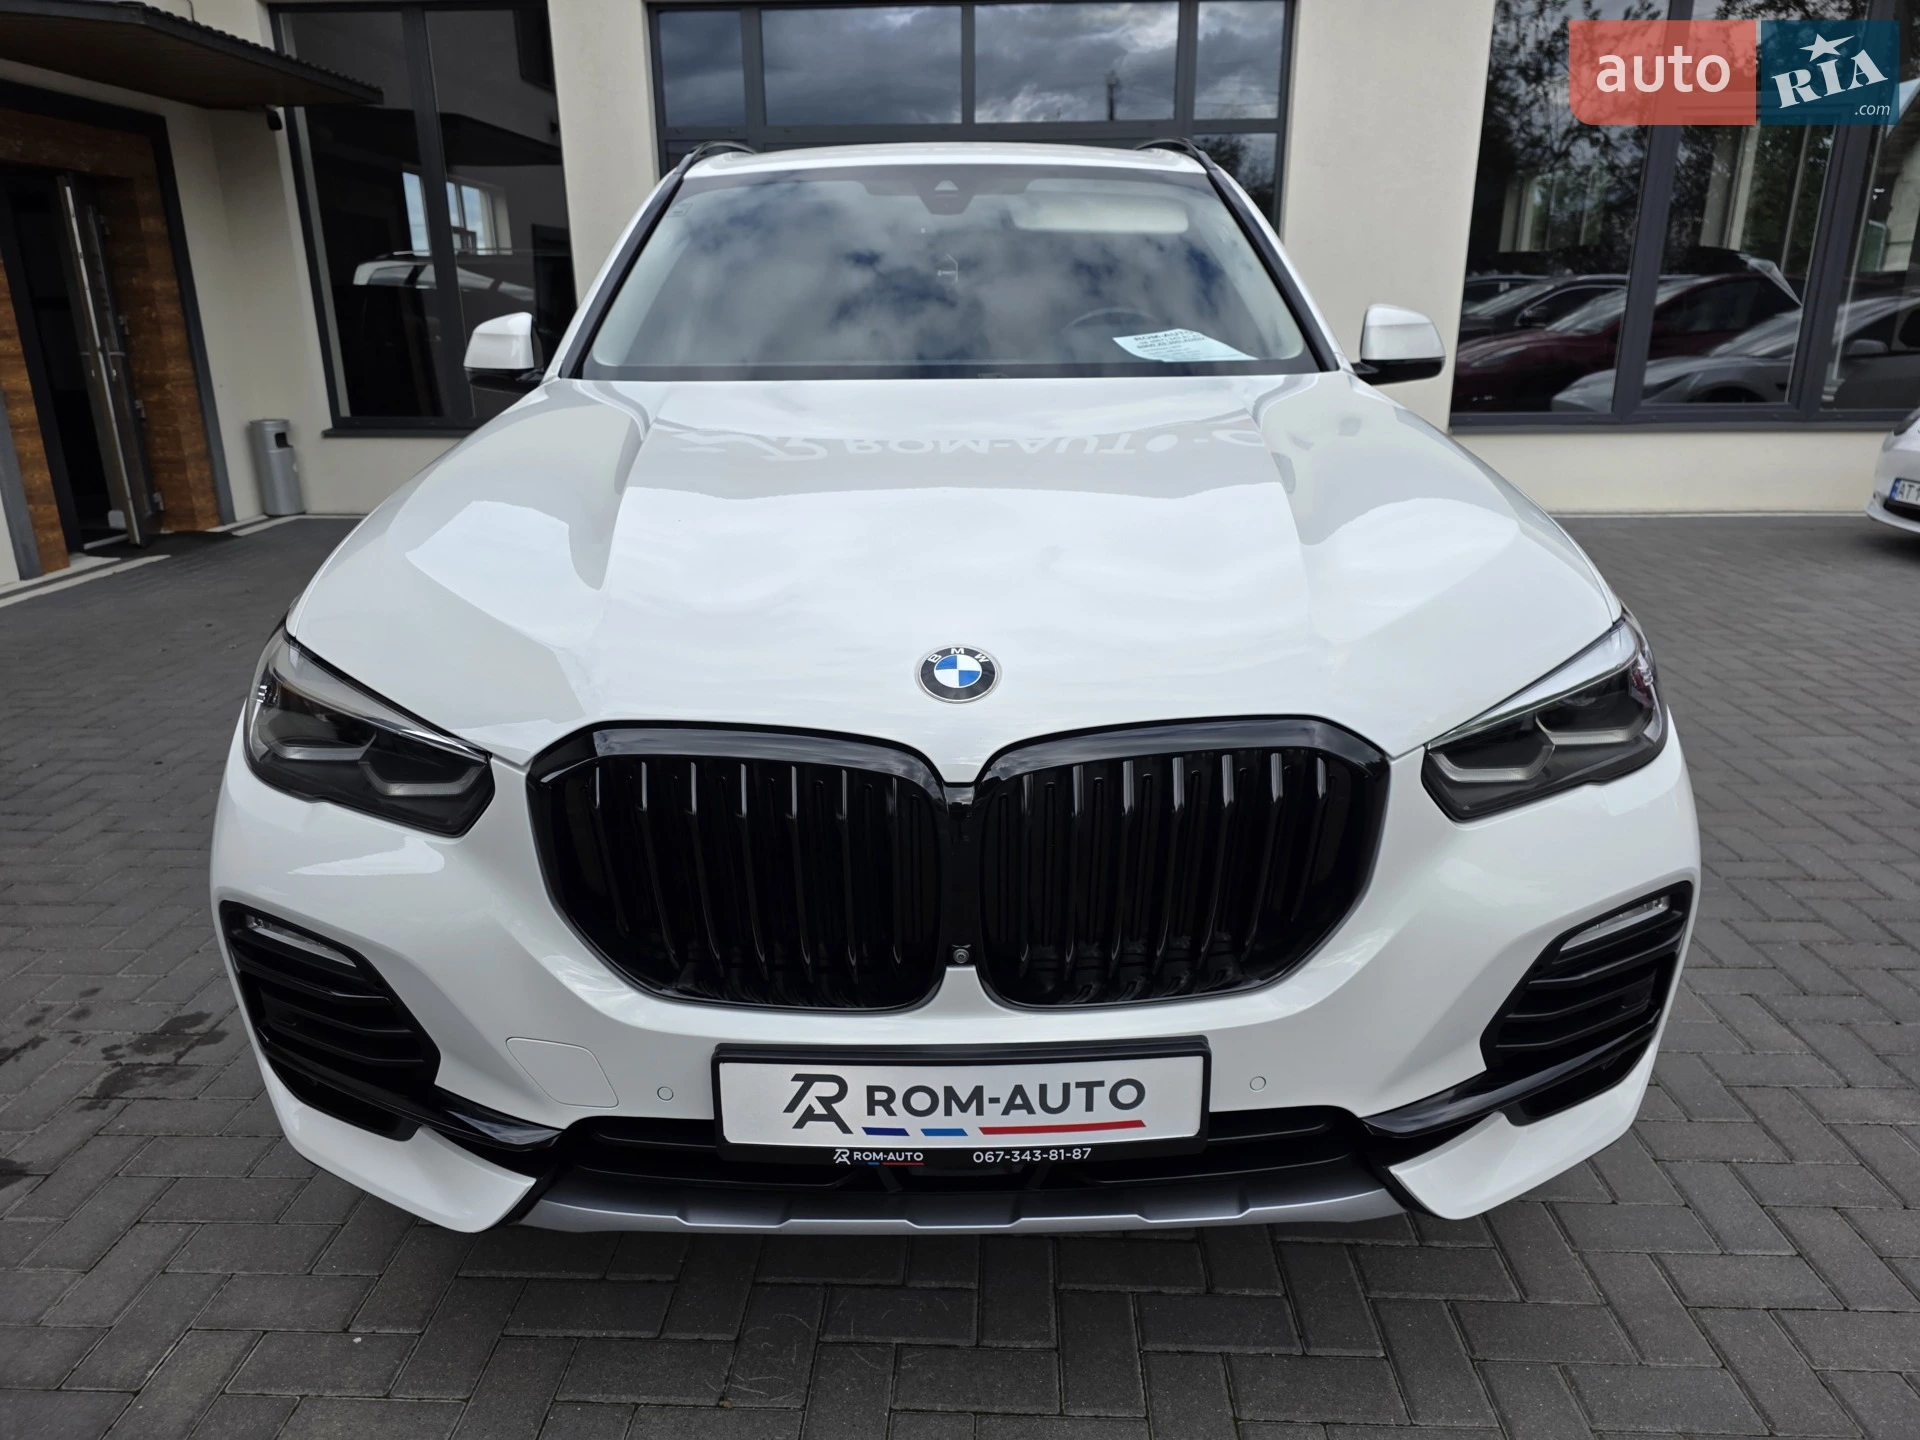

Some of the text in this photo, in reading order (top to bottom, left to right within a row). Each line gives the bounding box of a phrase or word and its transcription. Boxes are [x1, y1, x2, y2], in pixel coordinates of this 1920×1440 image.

[927, 647, 990, 663] BMW
[866, 1078, 1147, 1118] ROM-AUTO
[853, 1151, 924, 1162] ROM-AUTO
[972, 1148, 1092, 1163] 067-343-81-87
